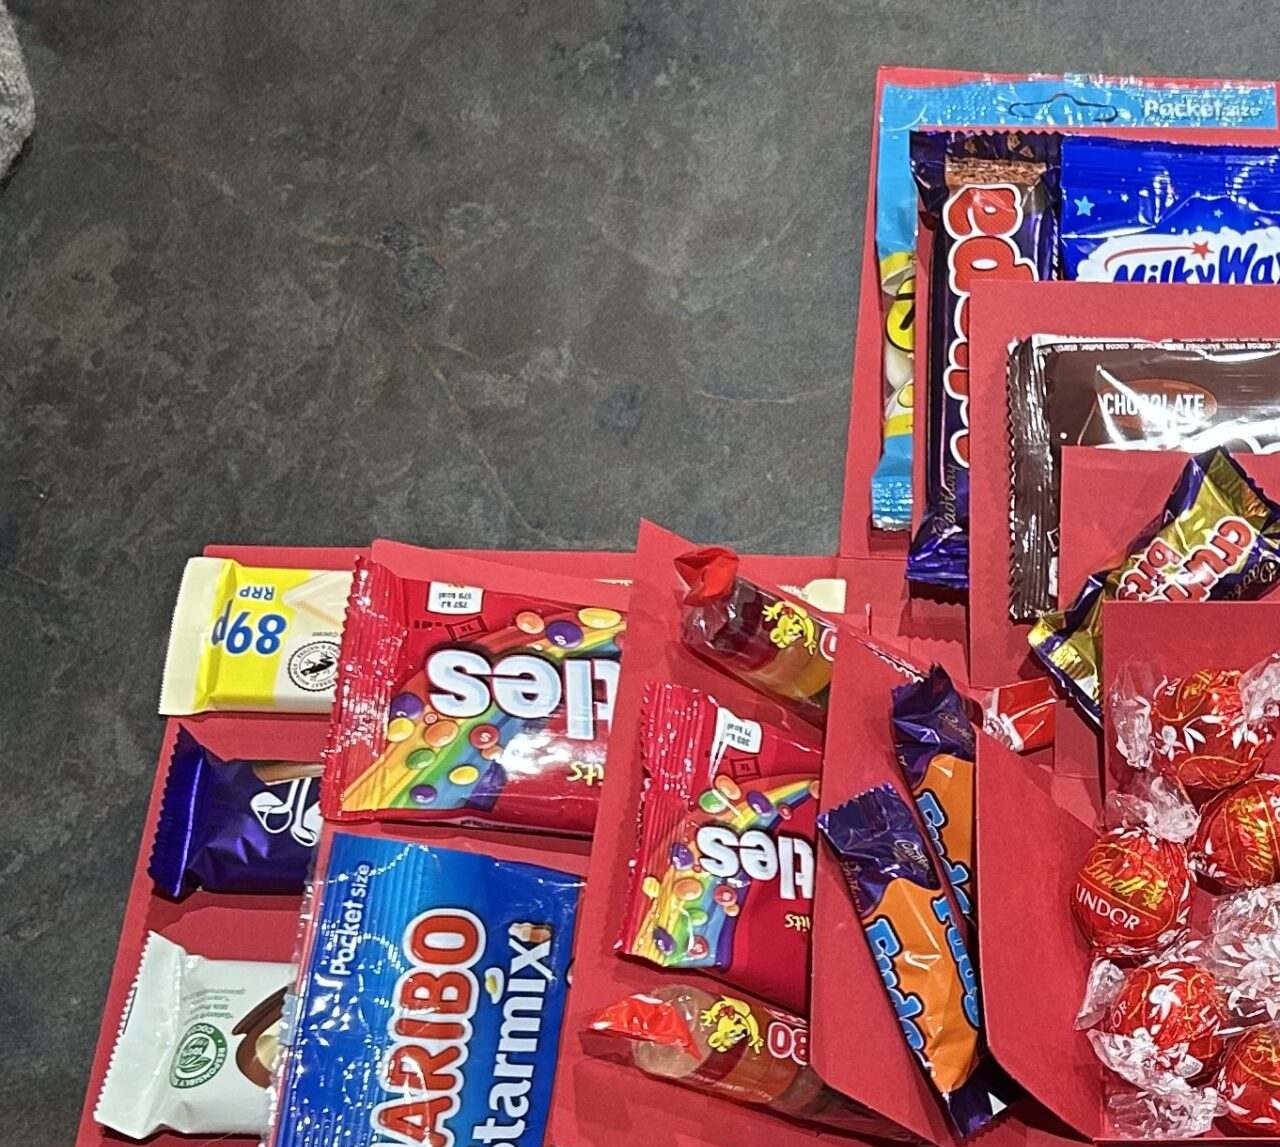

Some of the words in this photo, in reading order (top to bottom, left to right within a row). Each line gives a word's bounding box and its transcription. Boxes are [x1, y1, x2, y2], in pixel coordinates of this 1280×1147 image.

[1143, 98, 1221, 120] Pocket
[1102, 392, 1205, 416] CHOCOLATE
[239, 586, 275, 601] RRP
[211, 599, 287, 655] 89p
[327, 899, 368, 975] Pocket
